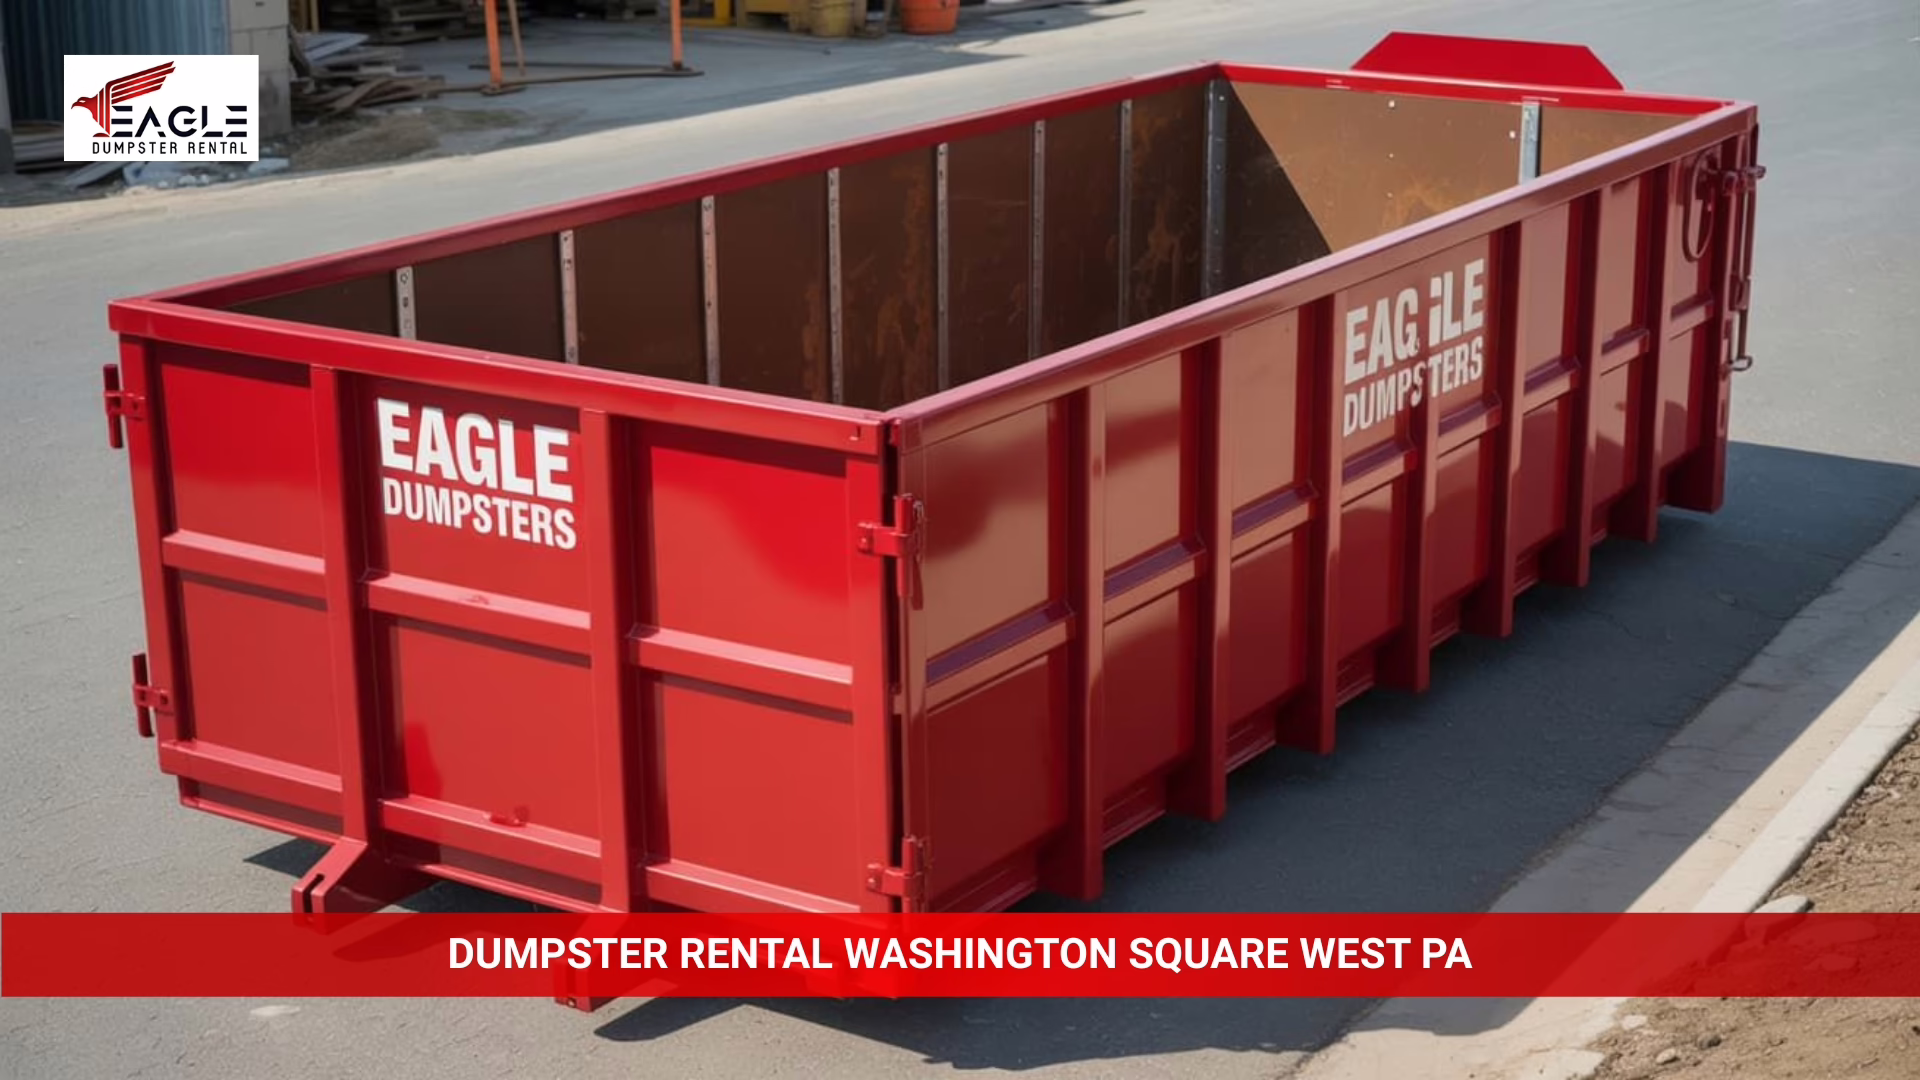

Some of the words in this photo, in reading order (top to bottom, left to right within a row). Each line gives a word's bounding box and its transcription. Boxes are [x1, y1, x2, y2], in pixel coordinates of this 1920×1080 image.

[1343, 335, 1483, 437] DUMPSTERS
[377, 397, 574, 503] EAGLE
[382, 477, 577, 550] DUMPSTERS
